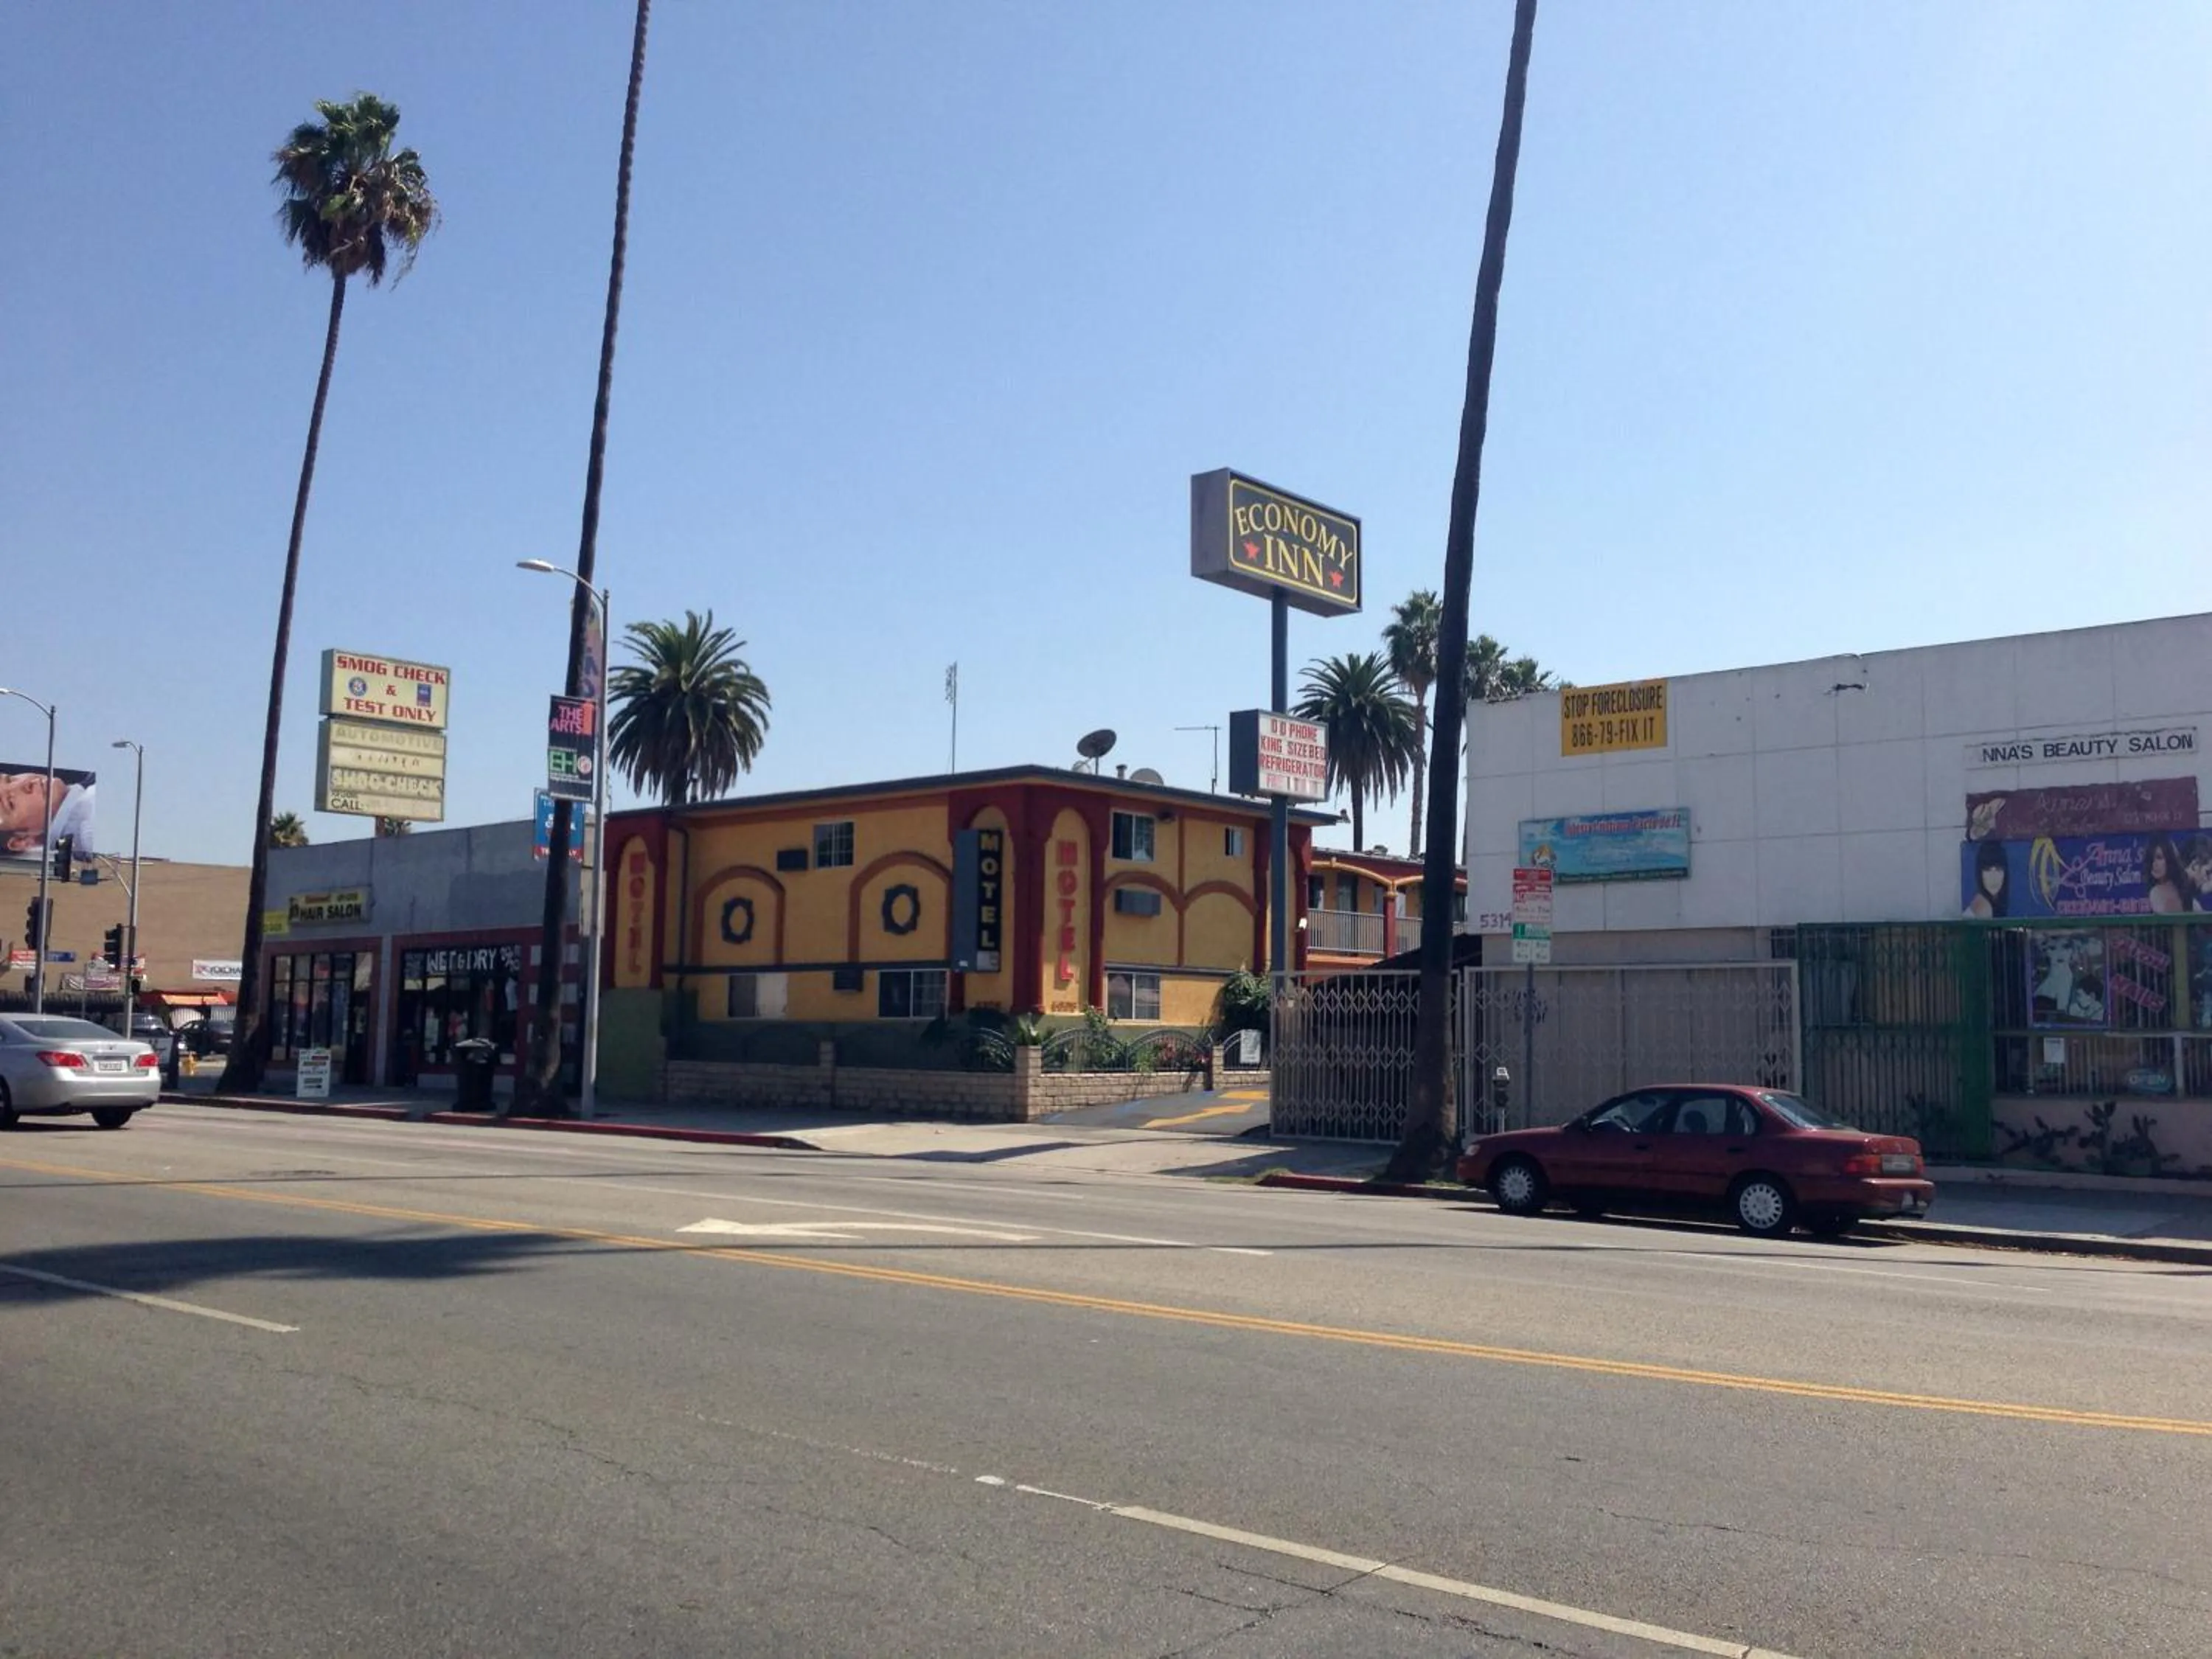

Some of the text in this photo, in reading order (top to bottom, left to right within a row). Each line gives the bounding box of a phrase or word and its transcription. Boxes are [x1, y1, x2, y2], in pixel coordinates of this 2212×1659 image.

[1234, 503, 1353, 571] ECONOMY
[1264, 534, 1324, 587] INN
[336, 655, 446, 685] SMOG CHECK
[386, 684, 397, 697] &
[1564, 685, 1663, 720] STOP FORECLOSURE
[344, 698, 437, 722] TEST ONLY
[558, 705, 583, 721] THE
[335, 726, 442, 751] AUTOMOTIVE
[550, 718, 582, 734] ARTS
[1289, 723, 1318, 742] PHONE
[1571, 717, 1655, 748] 866-79-FIX IT
[1261, 735, 1282, 752] KING
[1287, 741, 1307, 758] SIZE
[2043, 738, 2119, 758] BEAUTY
[2128, 734, 2194, 753] SALON
[2086, 838, 2144, 866] Anna's
[980, 832, 999, 947] MOTEL
[2080, 864, 2142, 891] Beauty Salon
[299, 903, 362, 920] HAIR SALON
